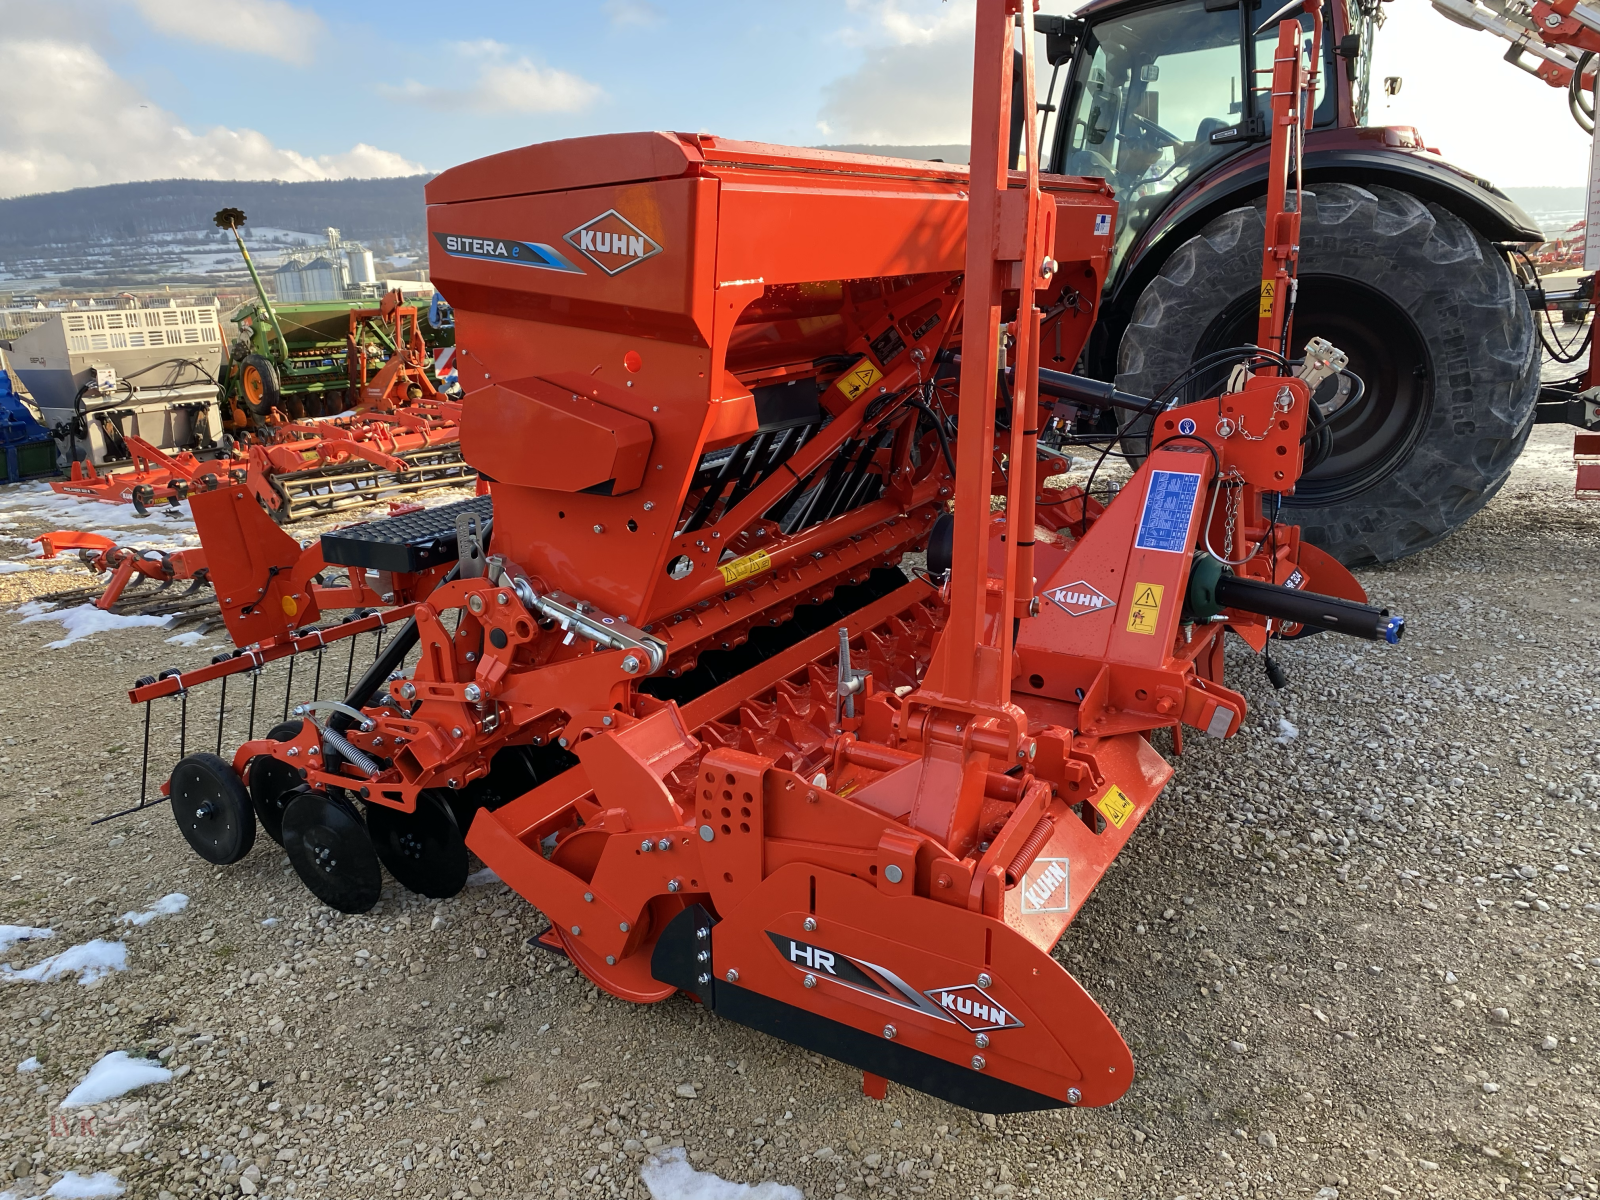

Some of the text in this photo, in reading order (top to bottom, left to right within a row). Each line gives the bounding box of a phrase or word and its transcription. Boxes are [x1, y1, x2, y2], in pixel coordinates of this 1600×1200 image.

[446, 236, 508, 257] SITERA
[580, 229, 645, 258] KUHN
[1054, 589, 1104, 609] KUHN
[1025, 861, 1067, 910] KUHN
[789, 941, 837, 976] HR
[941, 991, 1006, 1027] KUHN
